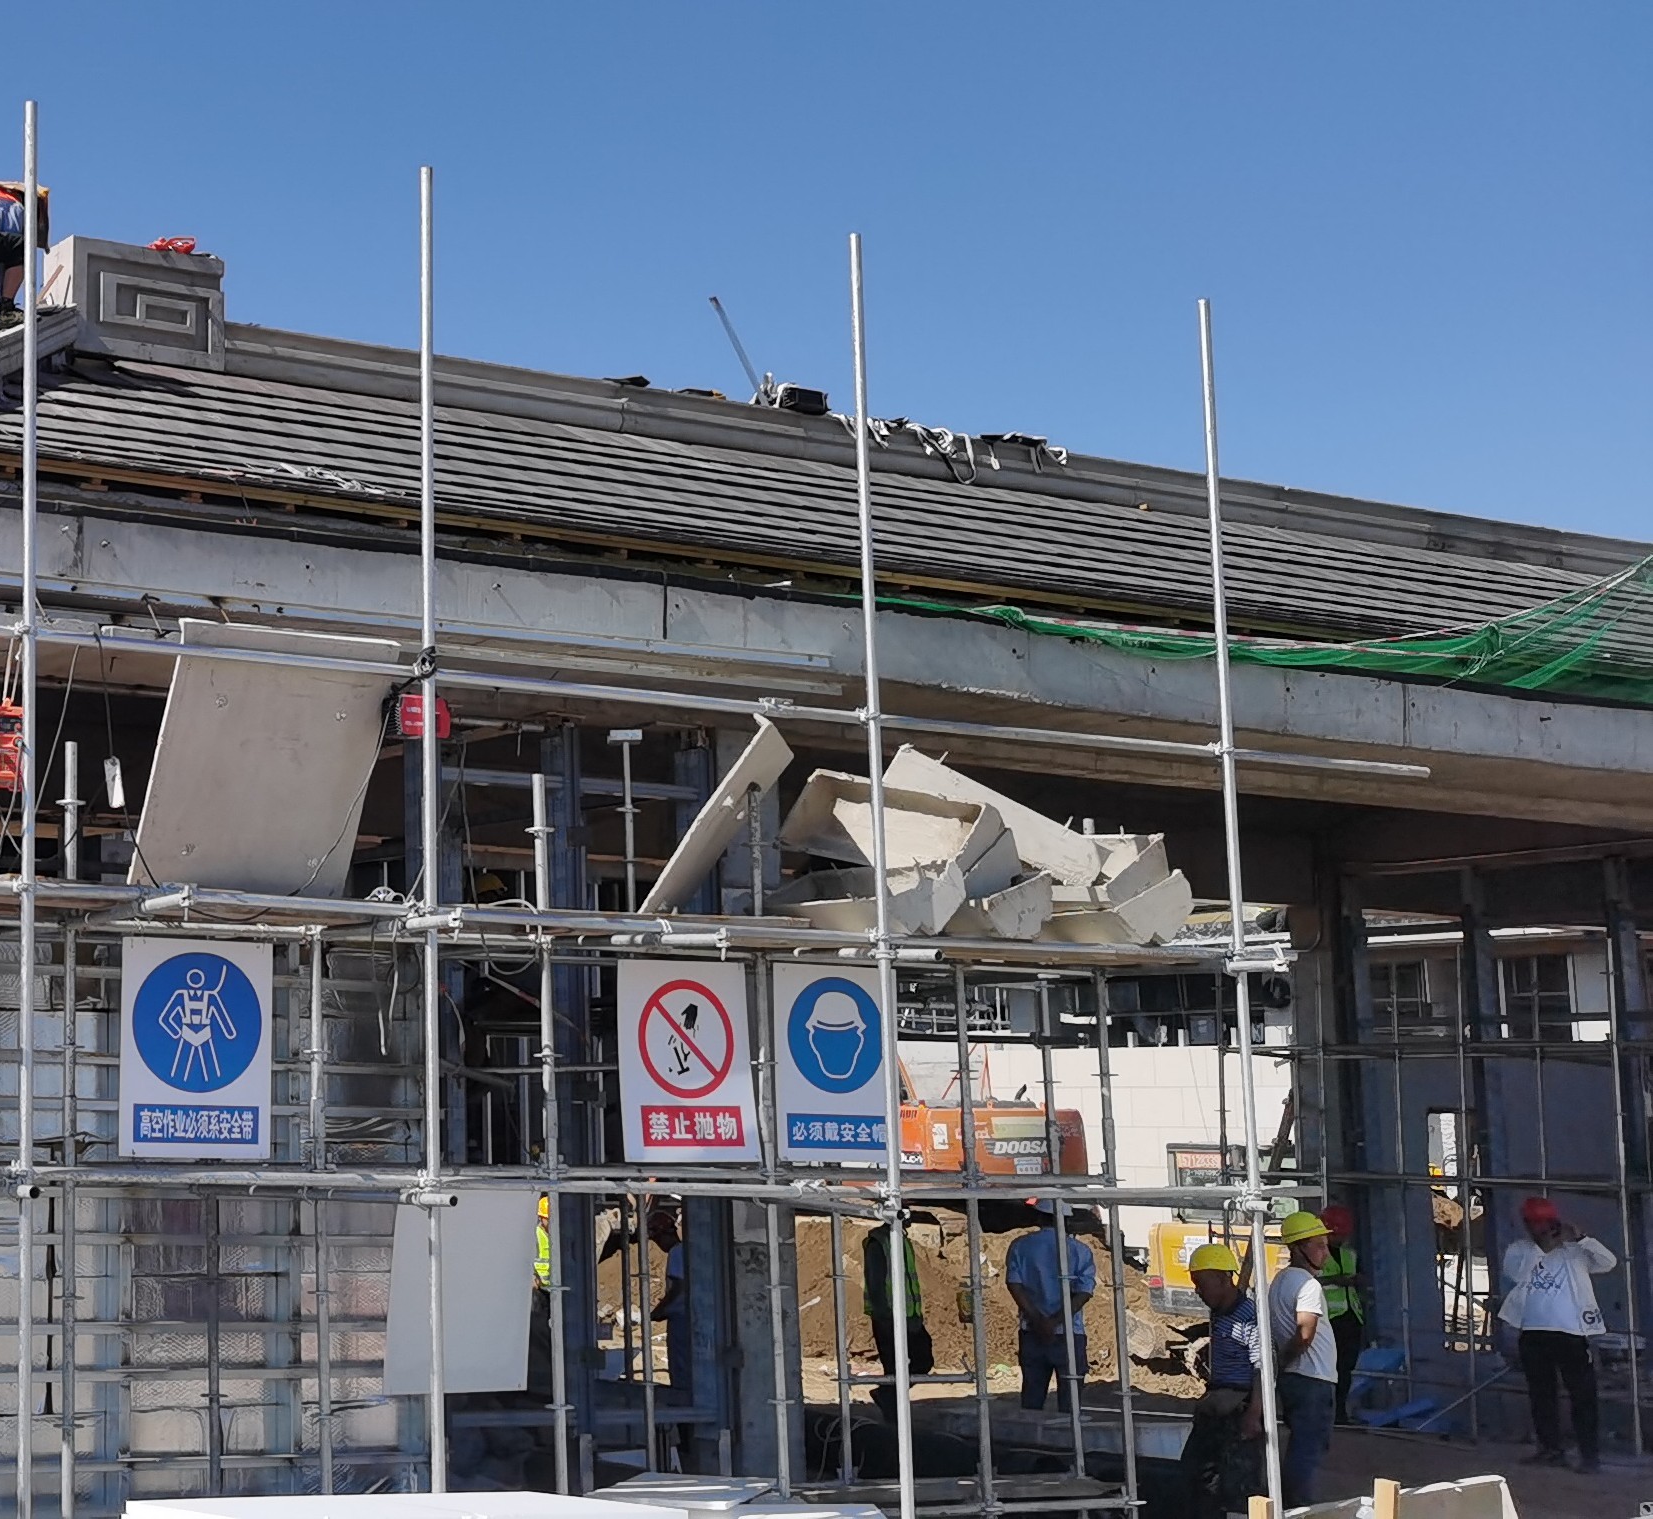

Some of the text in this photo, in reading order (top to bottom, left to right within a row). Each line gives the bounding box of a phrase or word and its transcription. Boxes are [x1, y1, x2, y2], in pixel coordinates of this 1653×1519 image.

[140, 1108, 253, 1139] 高空作业必须系安全带
[648, 1112, 738, 1140] 禁止抛物
[792, 1121, 887, 1143] 必须戴安全帽
[993, 1140, 1048, 1154] DOOSA
